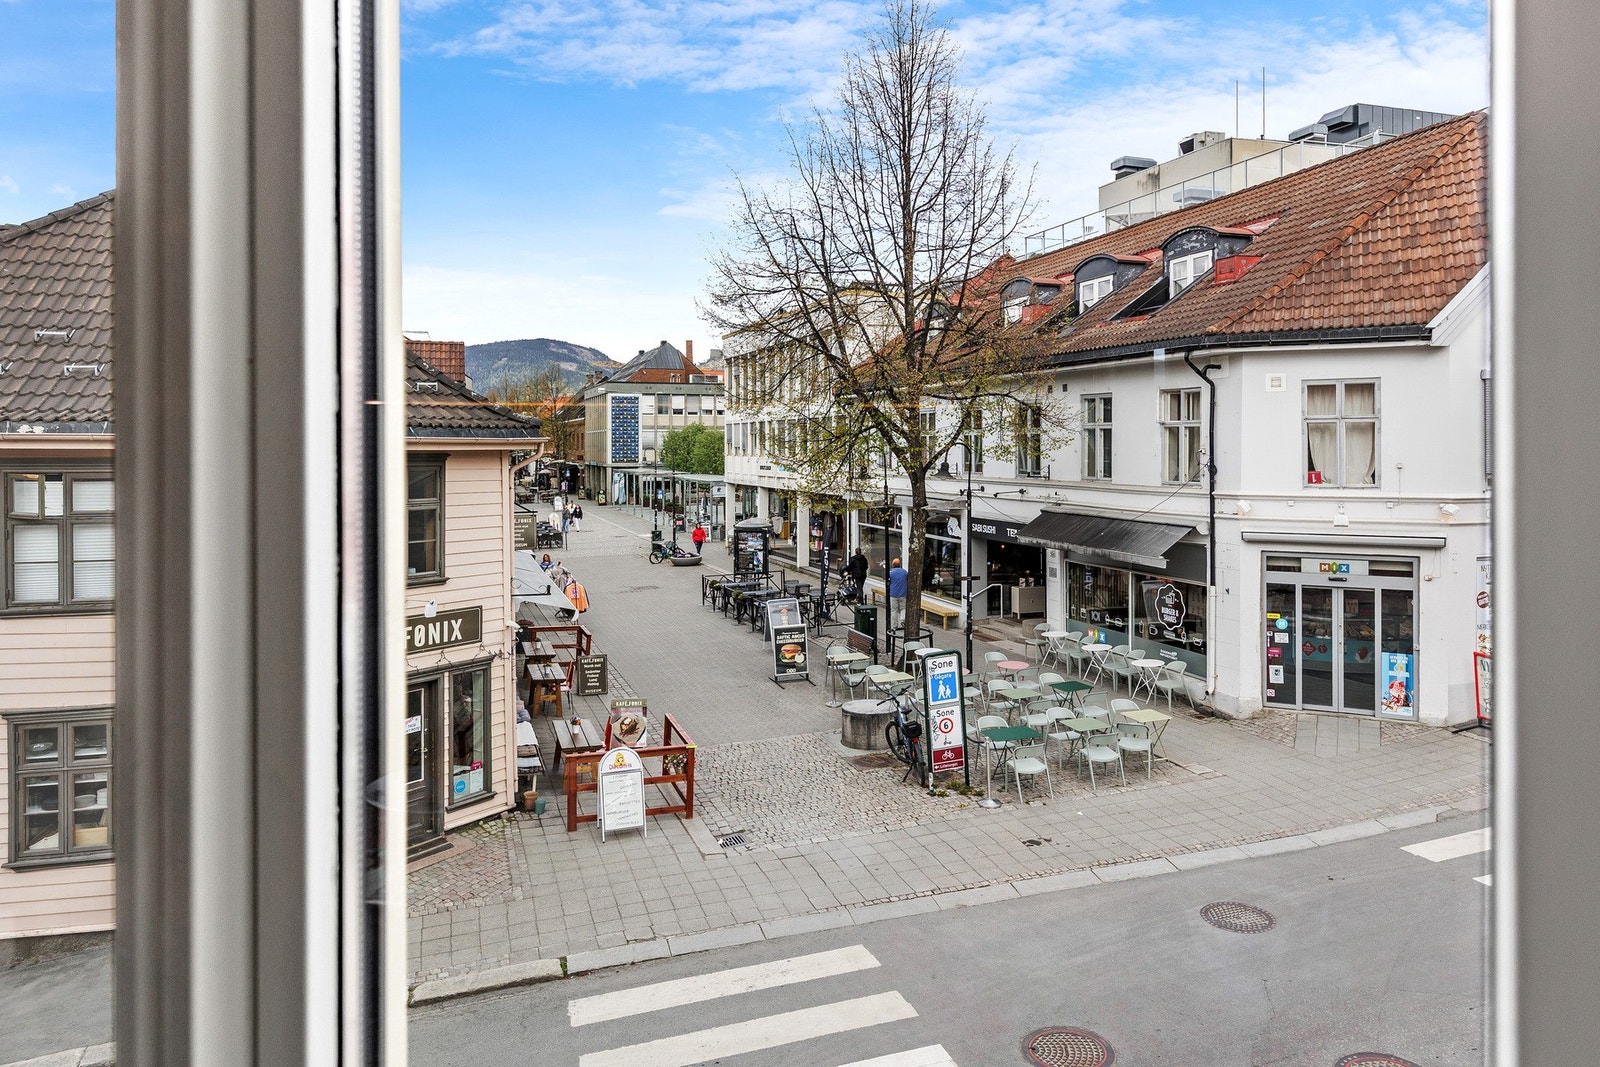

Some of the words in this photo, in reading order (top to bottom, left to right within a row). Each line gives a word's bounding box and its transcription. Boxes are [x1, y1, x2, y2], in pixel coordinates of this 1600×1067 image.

[982, 524, 997, 535] SUSHI
[1321, 563, 1348, 573] MIX
[406, 618, 463, 648] FØNIX
[1088, 628, 1106, 641] MIX
[931, 660, 953, 669] Sone
[936, 709, 954, 718] Sone
[943, 721, 949, 730] 6
